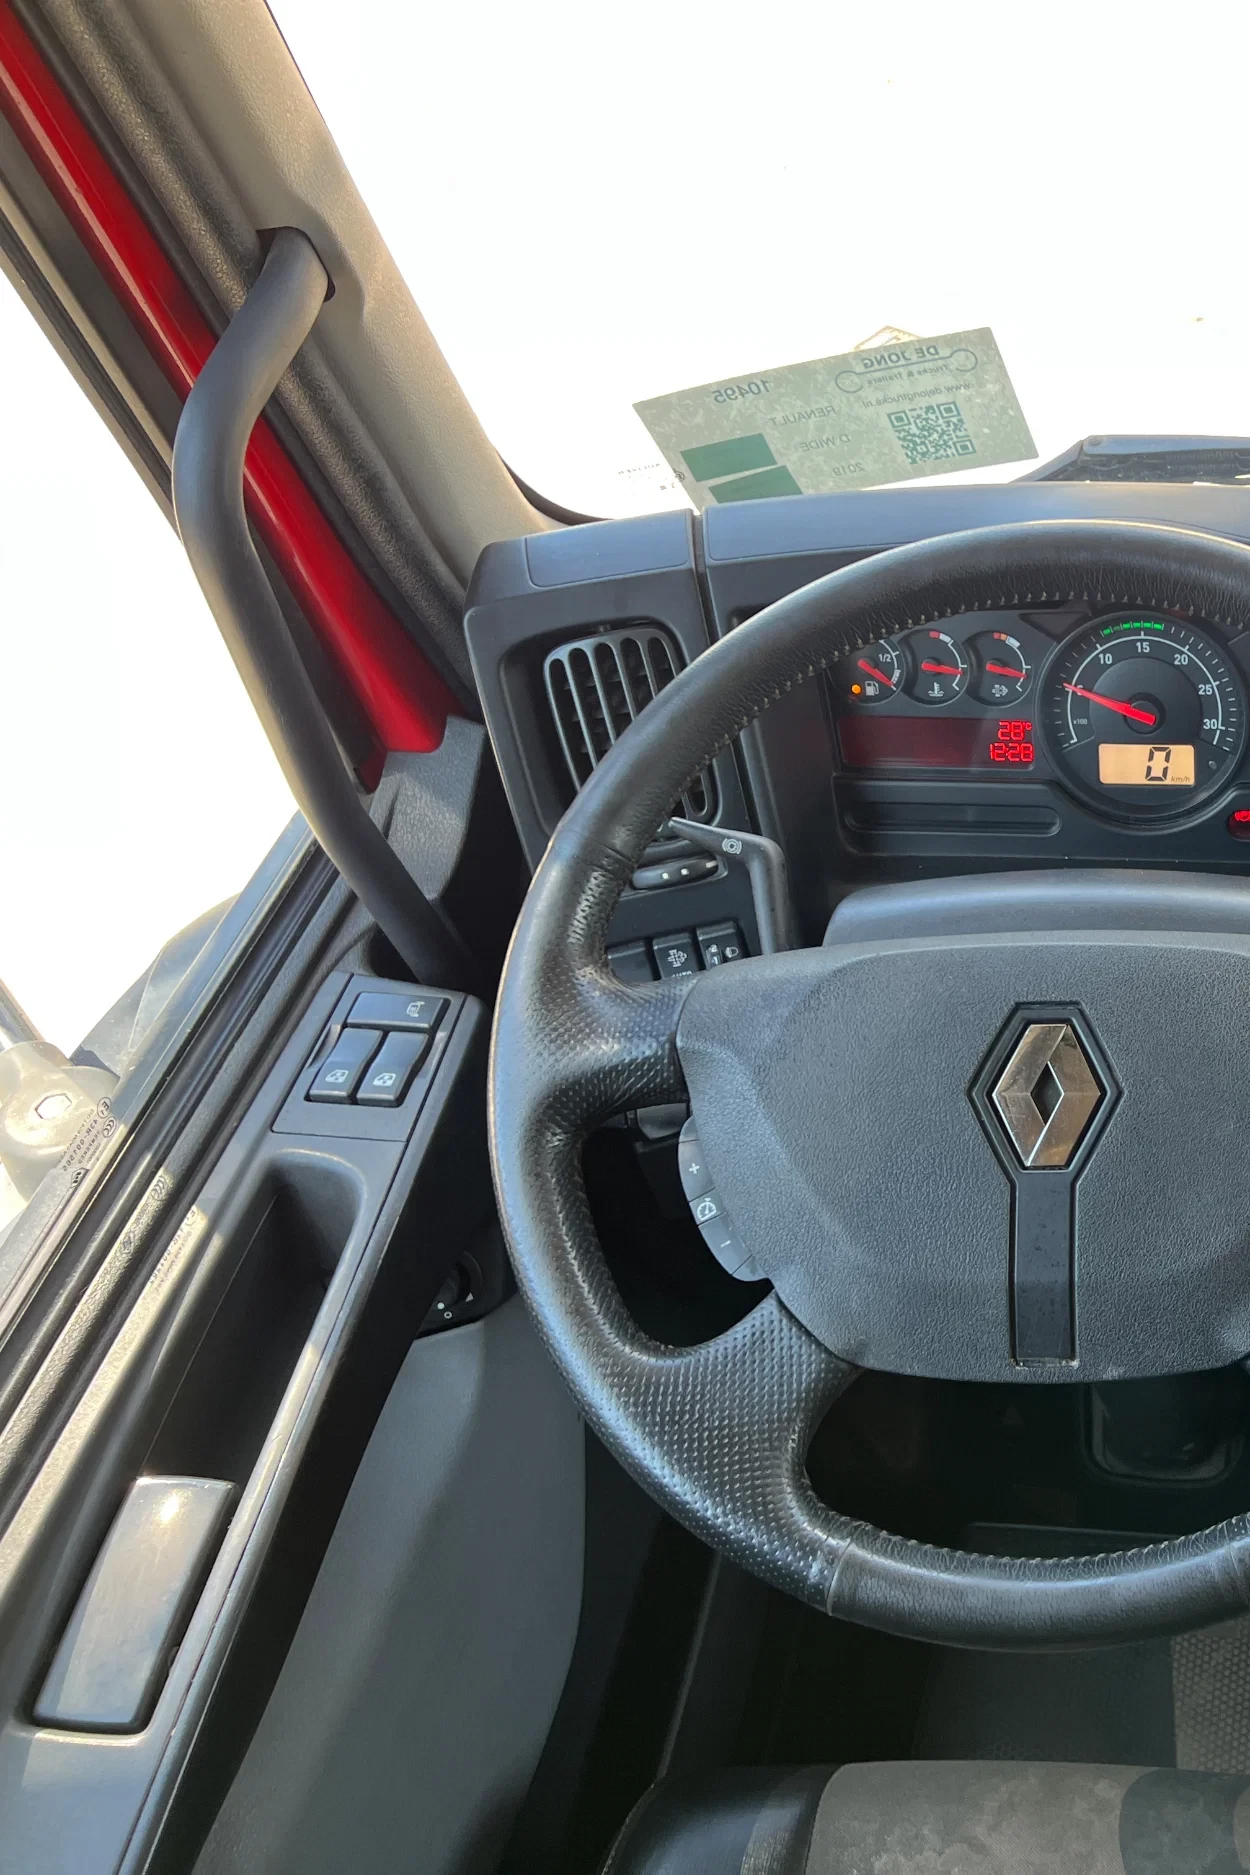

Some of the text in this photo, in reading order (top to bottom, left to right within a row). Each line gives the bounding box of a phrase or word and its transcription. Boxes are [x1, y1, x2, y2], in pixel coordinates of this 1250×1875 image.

[1136, 642, 1150, 653] 15
[878, 653, 892, 663] 1/2
[1098, 653, 1113, 665] 10
[1174, 654, 1189, 666] 20
[1198, 684, 1213, 695] 25
[1203, 719, 1218, 730] 30
[989, 742, 1034, 762] 12:28
[1145, 746, 1191, 783] 0 km/h
